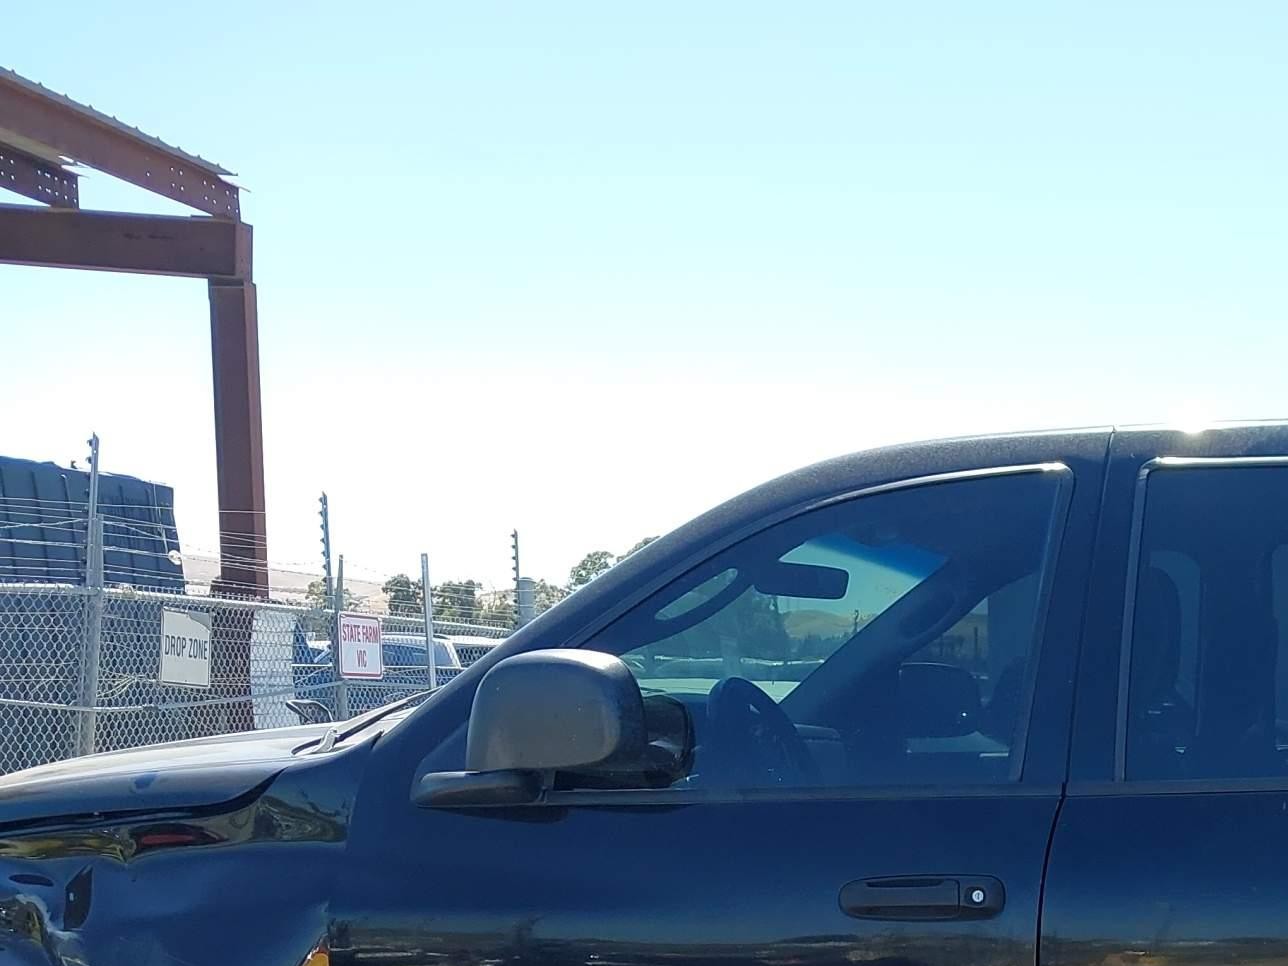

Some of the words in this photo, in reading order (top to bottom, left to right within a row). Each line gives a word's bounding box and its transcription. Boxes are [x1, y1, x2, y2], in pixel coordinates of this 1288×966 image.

[342, 623, 361, 642] STATE
[361, 624, 379, 643] FARM
[165, 635, 187, 657] DROP
[188, 638, 208, 660] ZONE
[356, 649, 367, 668] VIC
